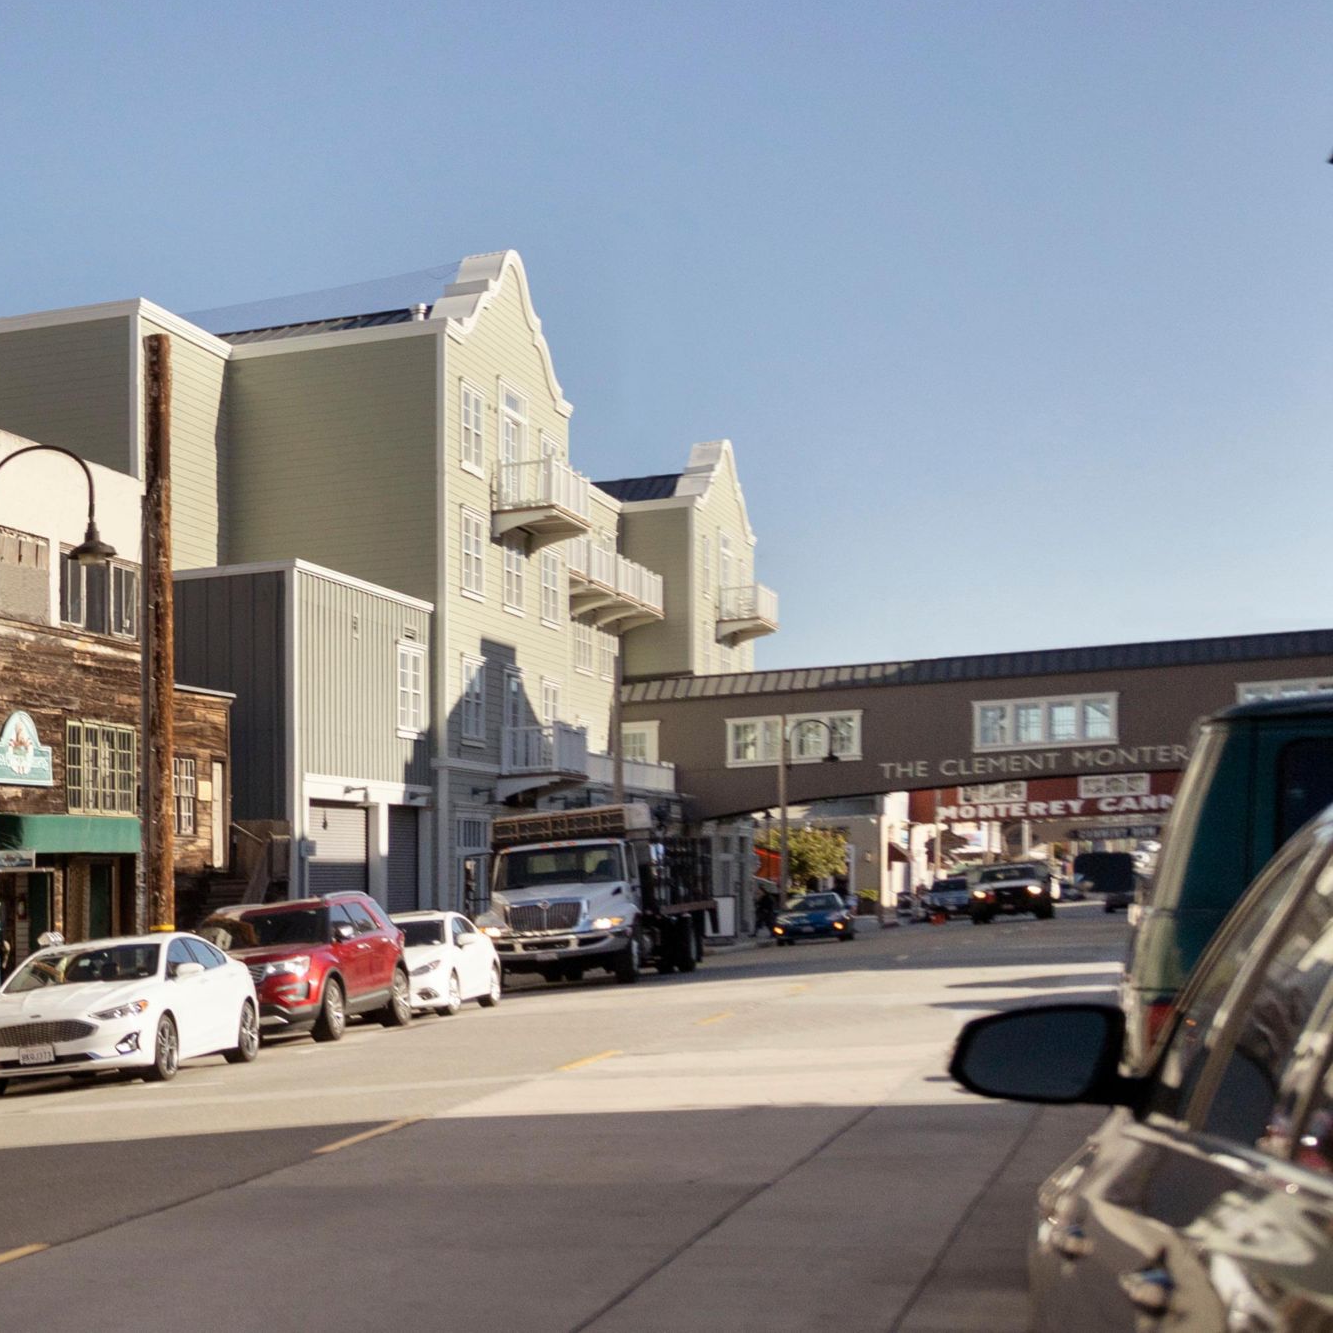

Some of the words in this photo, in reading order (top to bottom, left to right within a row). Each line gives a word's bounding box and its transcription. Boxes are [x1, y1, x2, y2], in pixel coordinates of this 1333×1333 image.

[878, 760, 930, 779] THE
[938, 751, 1061, 777] CLEMENT
[934, 797, 1086, 821] MONTEREY
